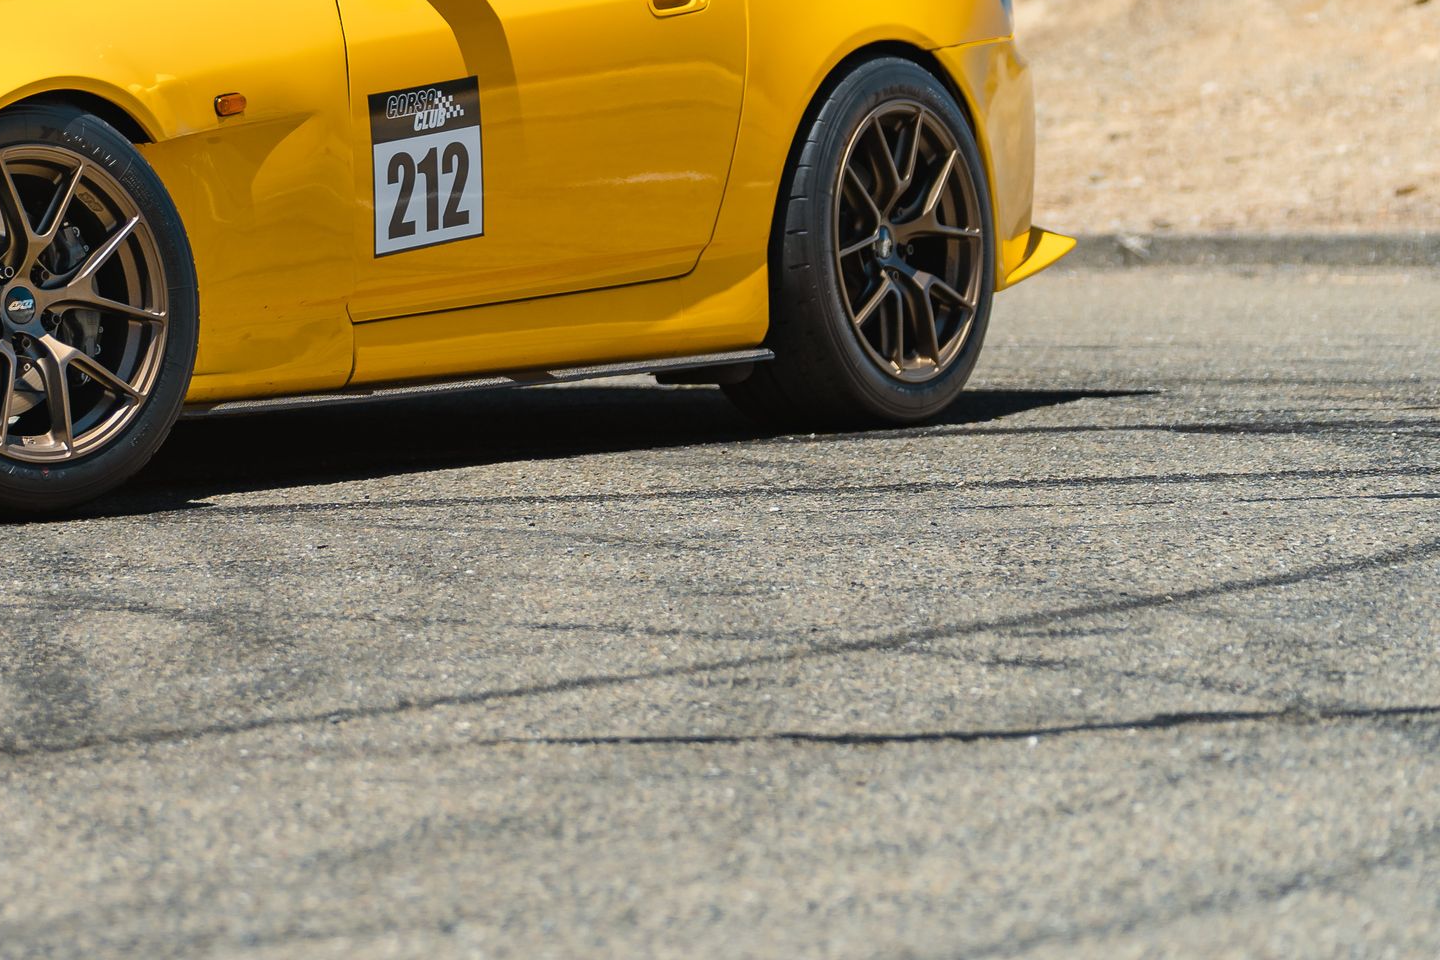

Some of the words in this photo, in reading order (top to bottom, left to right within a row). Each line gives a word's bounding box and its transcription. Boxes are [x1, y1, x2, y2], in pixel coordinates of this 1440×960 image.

[386, 88, 437, 119] CORSA
[413, 108, 446, 131] CLUB
[387, 141, 469, 240] 212
